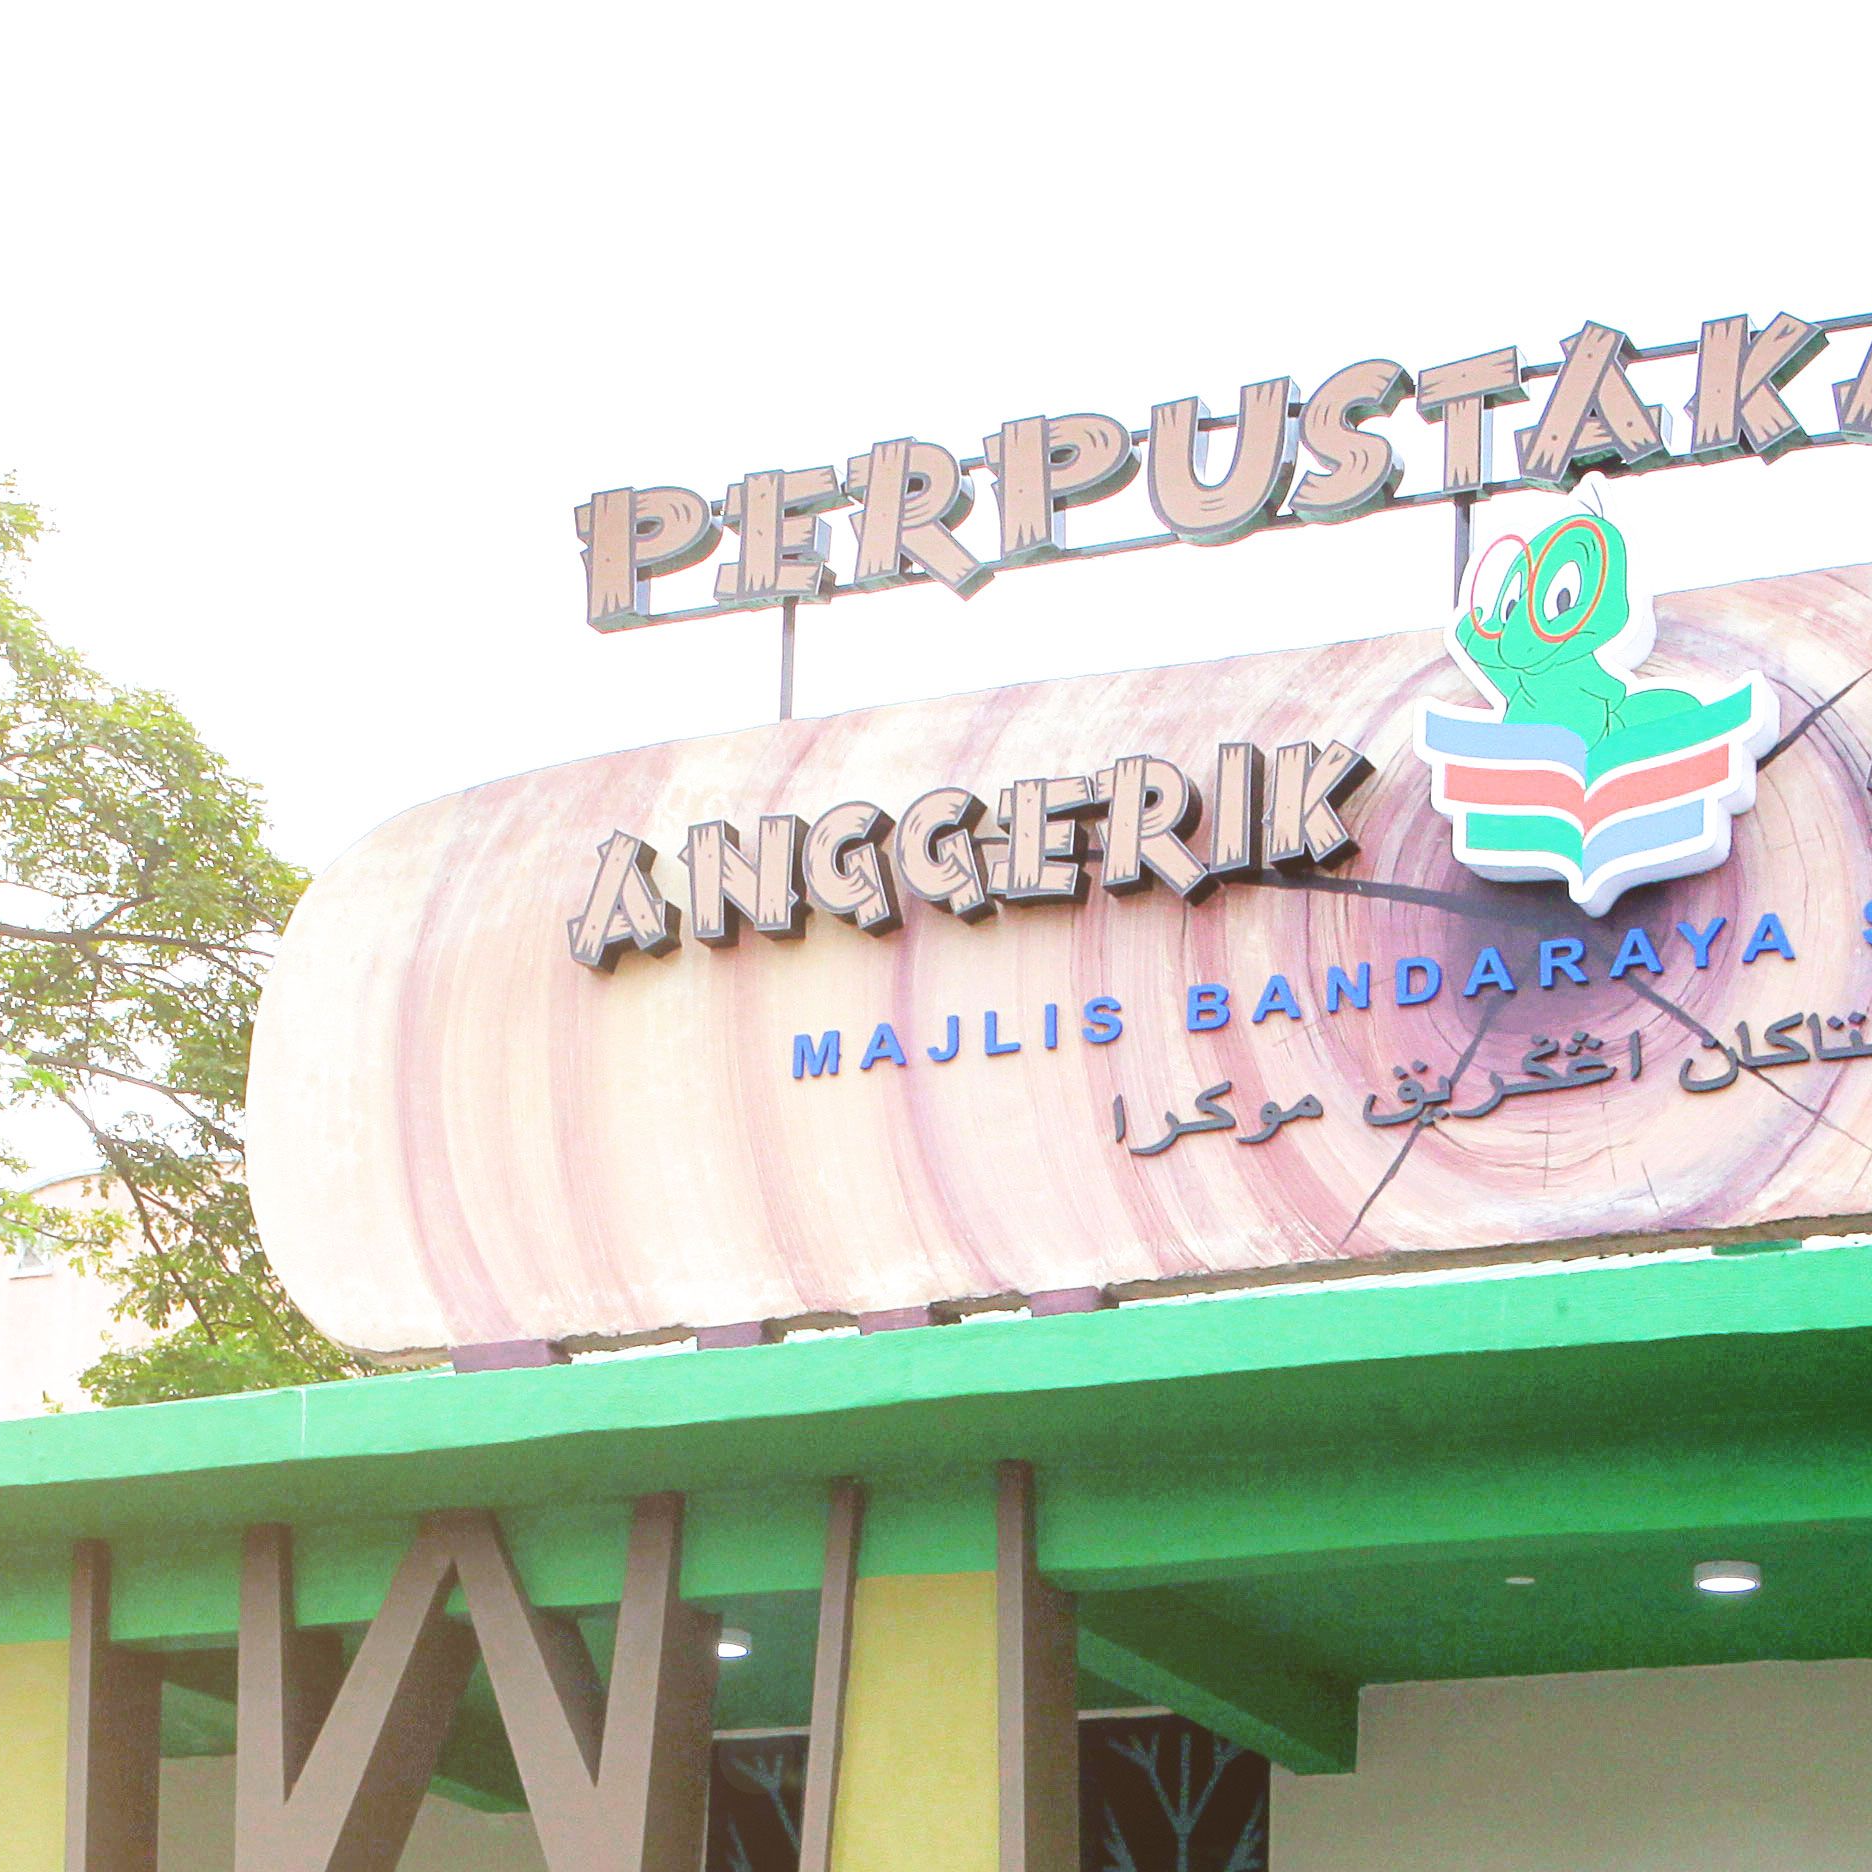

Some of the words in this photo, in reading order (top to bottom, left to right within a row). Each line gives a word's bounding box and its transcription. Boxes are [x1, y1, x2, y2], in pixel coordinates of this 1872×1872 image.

[567, 739, 1376, 973] ANGGERIK
[791, 995, 1124, 1081] MAJLIS
[1184, 911, 1796, 1033] BANDARAYA
